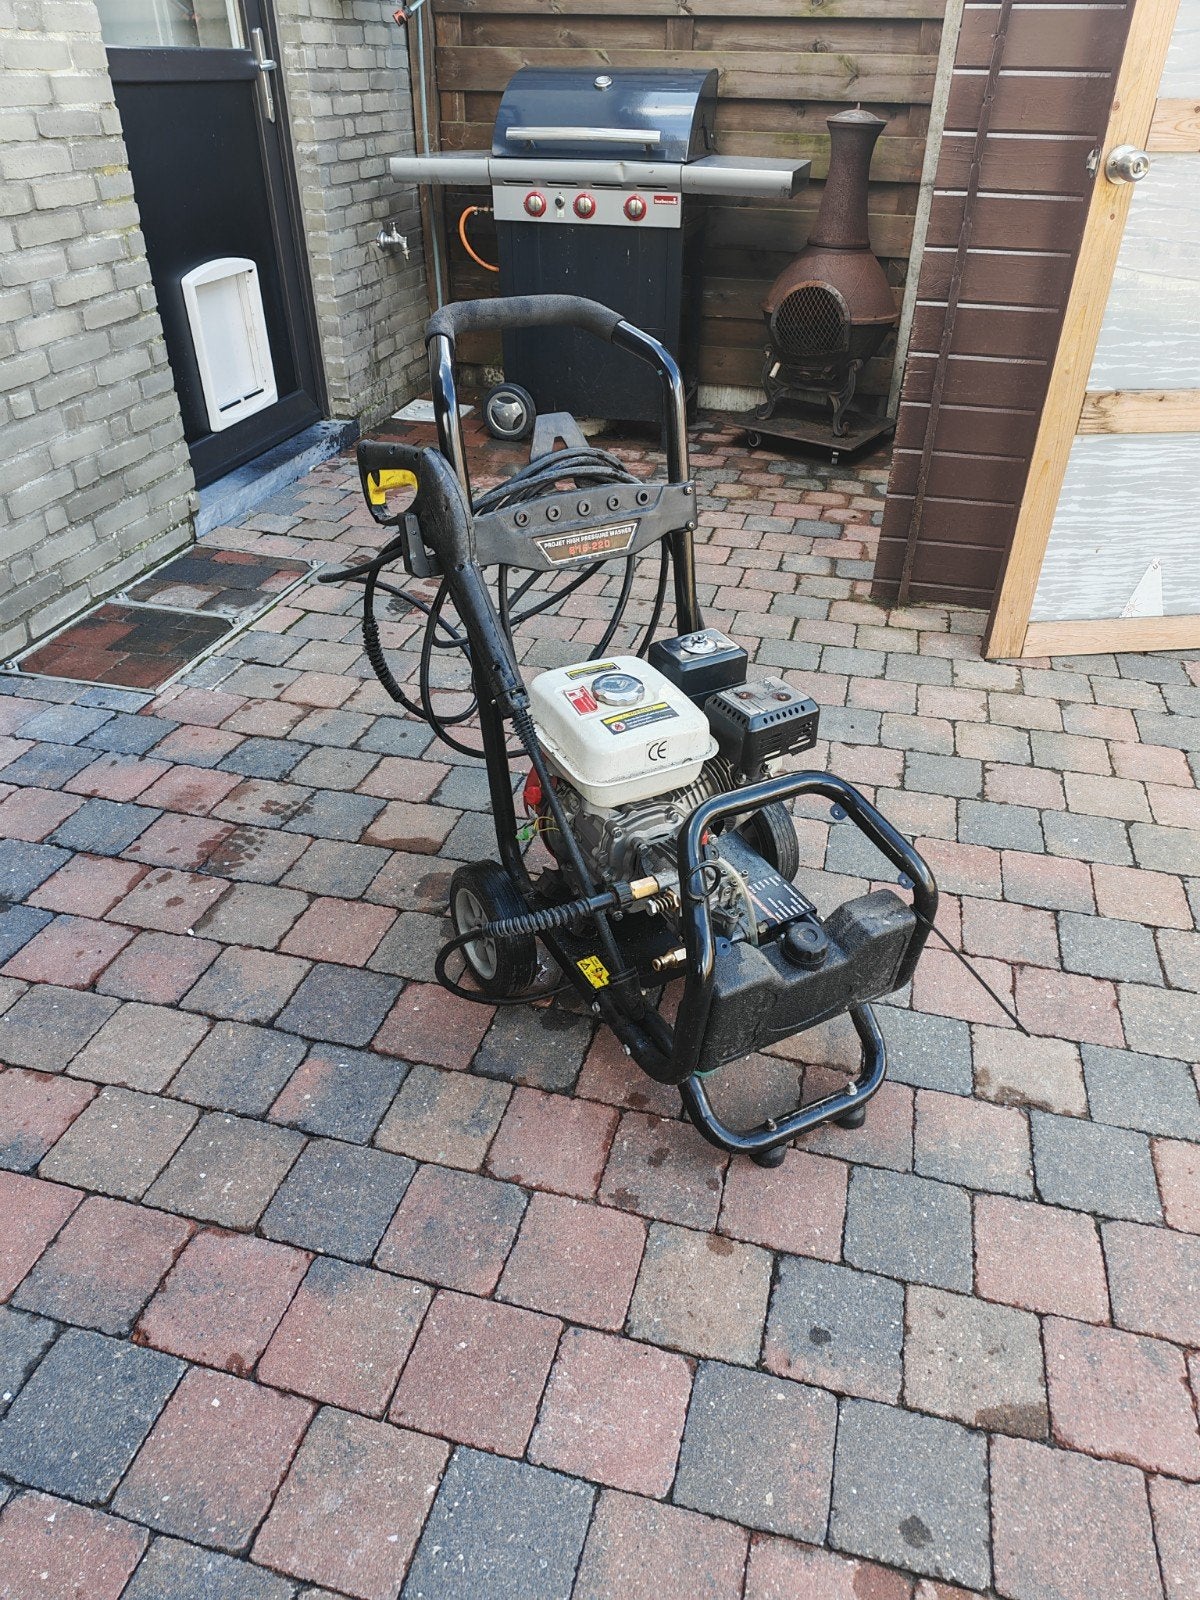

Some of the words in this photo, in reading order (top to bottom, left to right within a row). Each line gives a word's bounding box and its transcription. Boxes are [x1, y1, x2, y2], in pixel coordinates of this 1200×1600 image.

[544, 540, 566, 549] PROJET
[566, 537, 580, 545] HIGH
[581, 531, 609, 542] PRESSURE
[648, 740, 668, 761] CE
